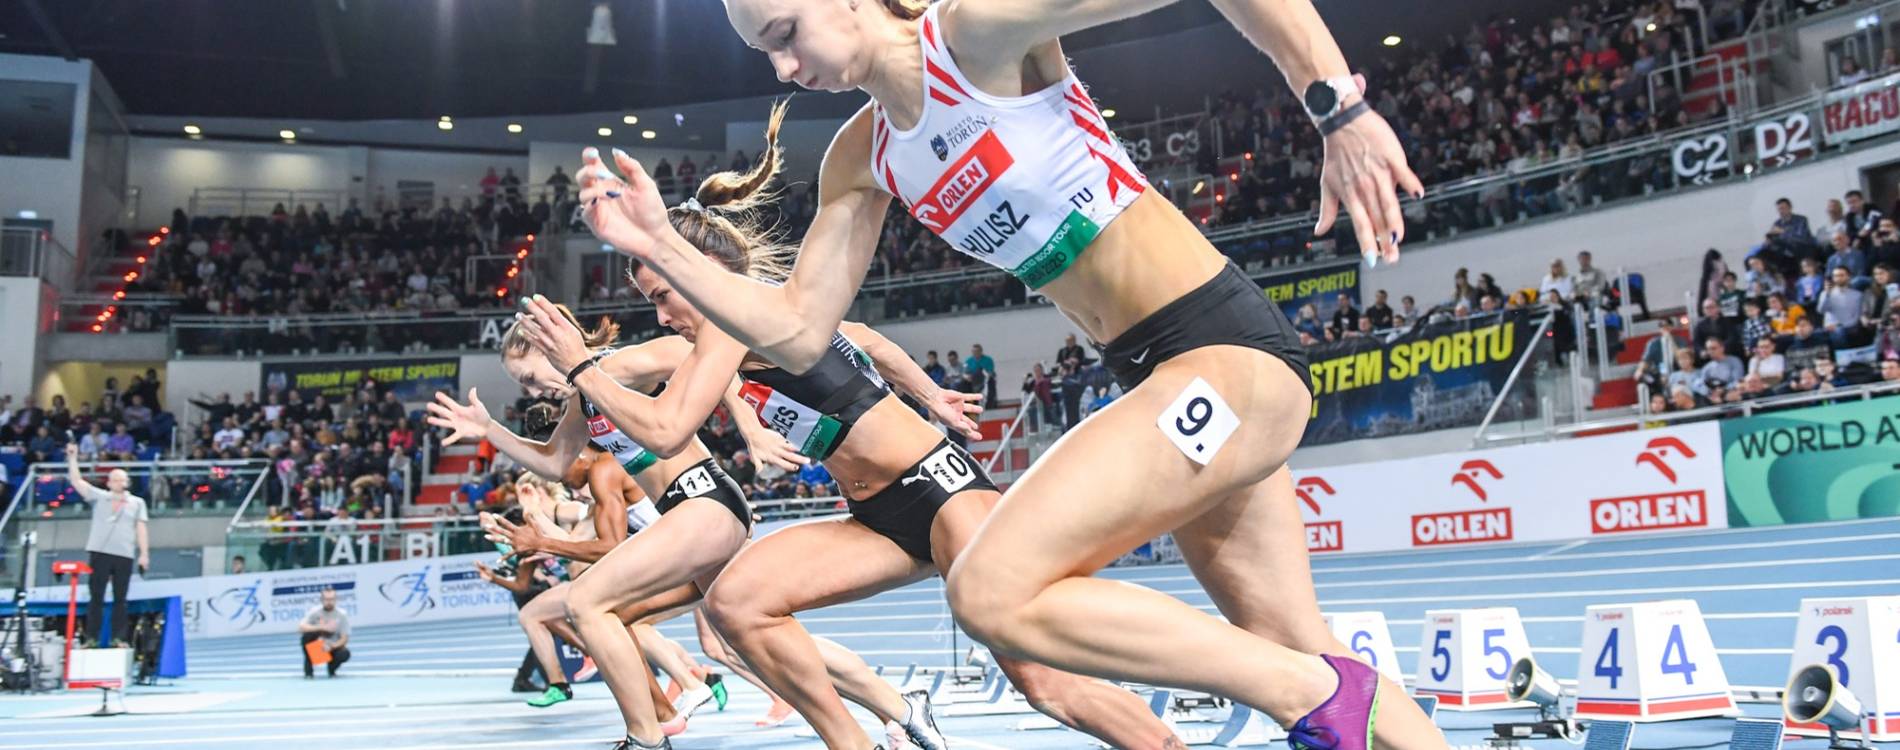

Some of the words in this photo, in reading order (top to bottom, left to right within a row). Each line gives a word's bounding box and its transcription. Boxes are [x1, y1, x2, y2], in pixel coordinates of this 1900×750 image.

[1166, 129, 1200, 157] C3
[1755, 112, 1812, 160] D2
[1672, 134, 1728, 177] C2
[941, 163, 983, 209] ORLEN
[1052, 222, 1072, 244] TOUR
[1263, 283, 1294, 303] TEM
[1298, 270, 1357, 298] SPORTU
[408, 362, 457, 379] SPORTU
[1388, 322, 1514, 381] SPORTU
[1739, 420, 1865, 460] WORLD
[1415, 512, 1508, 543] ORLEN
[1594, 496, 1702, 528] ORLEN
[330, 534, 370, 565] A1
[407, 533, 440, 560] B1
[1308, 525, 1339, 549] EN
[183, 600, 201, 621] EJ
[1351, 630, 1377, 668] 6
[1431, 630, 1451, 682] 5
[1483, 629, 1512, 680] 5
[1595, 628, 1622, 689] 4
[1661, 624, 1696, 685] 4
[1816, 625, 1849, 688] 3
